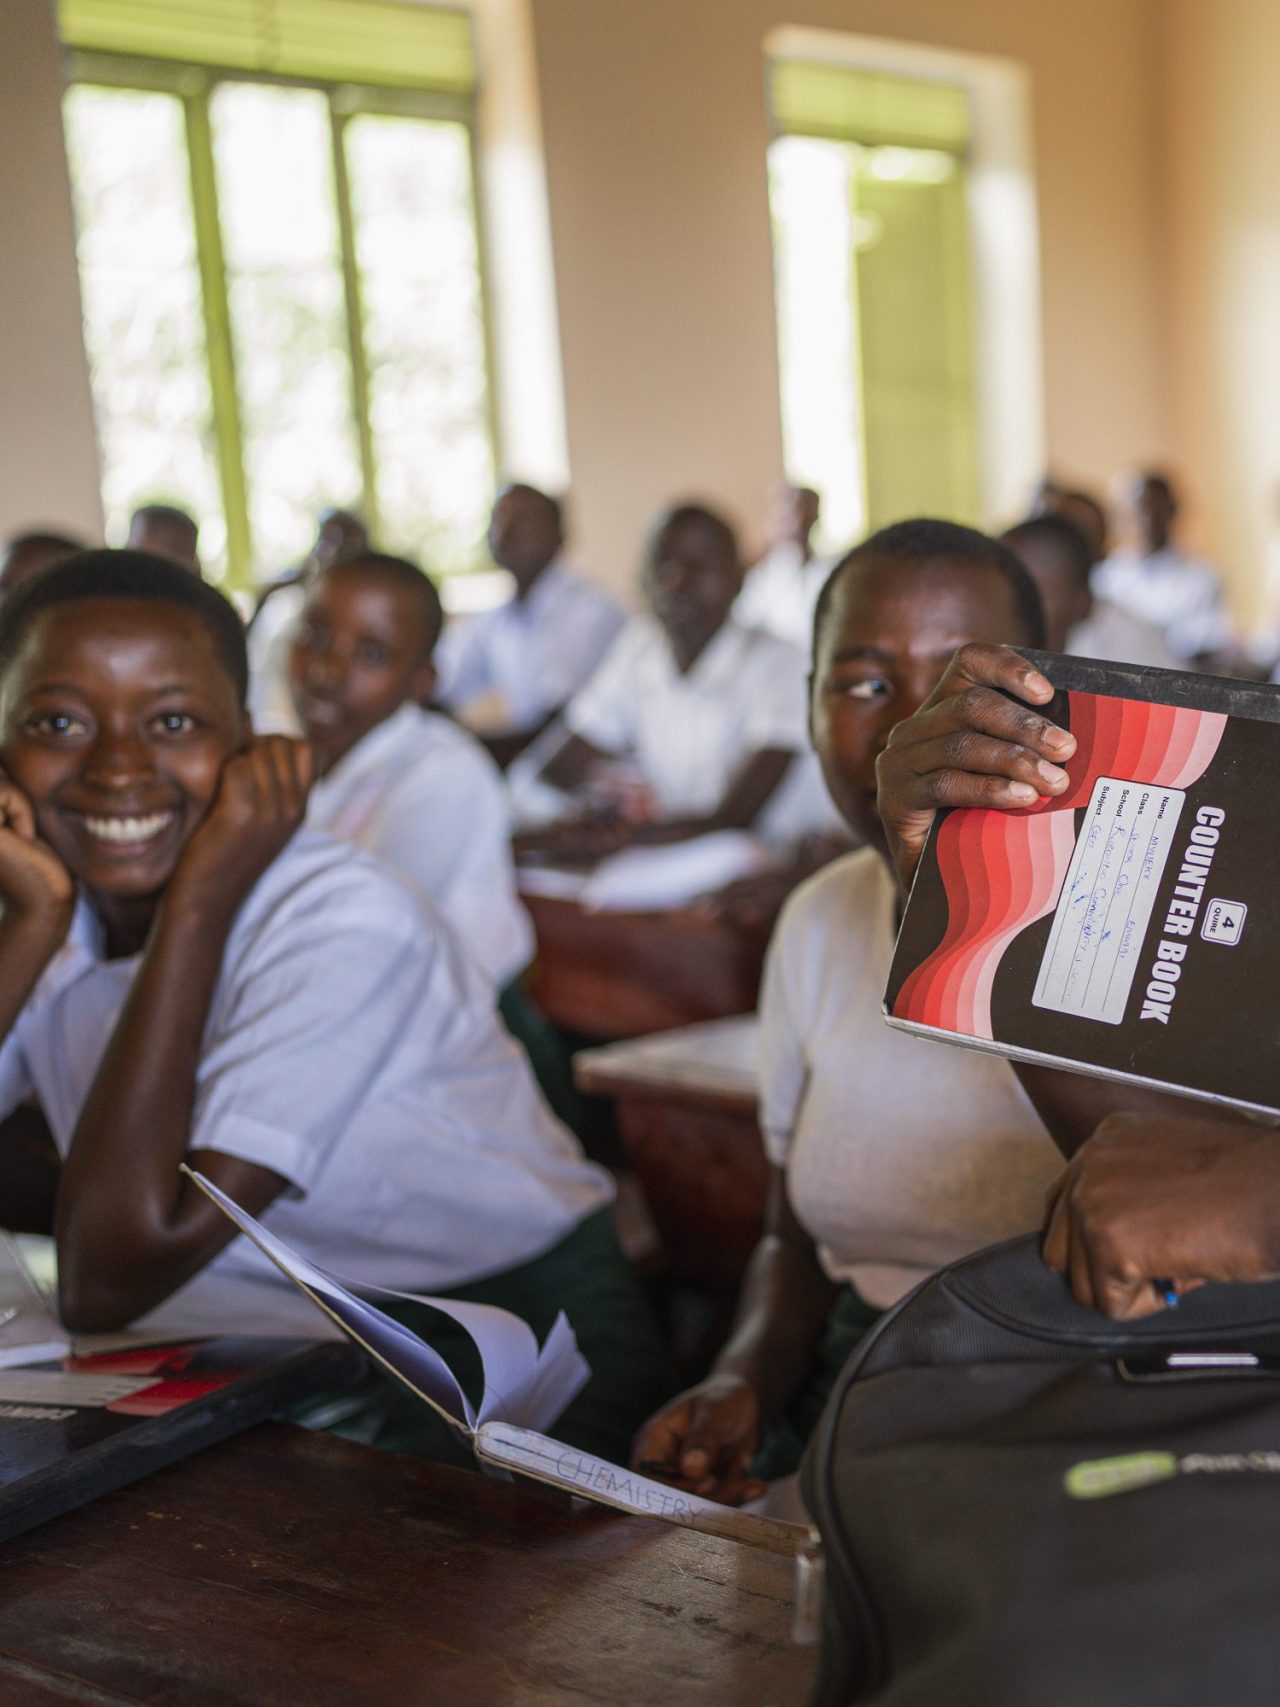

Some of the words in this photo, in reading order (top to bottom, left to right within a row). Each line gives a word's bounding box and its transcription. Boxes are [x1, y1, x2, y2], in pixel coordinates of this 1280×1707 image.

[1094, 785, 1109, 815] Subject
[1115, 789, 1129, 816] School
[1137, 792, 1149, 814] Class
[1157, 796, 1169, 819] Name
[1162, 805, 1227, 936] COUNTER
[1209, 907, 1222, 933] QUIRE
[1221, 917, 1234, 928] 4
[1139, 939, 1187, 1024] BOOK
[556, 1451, 706, 1526] CHEMISTRY
